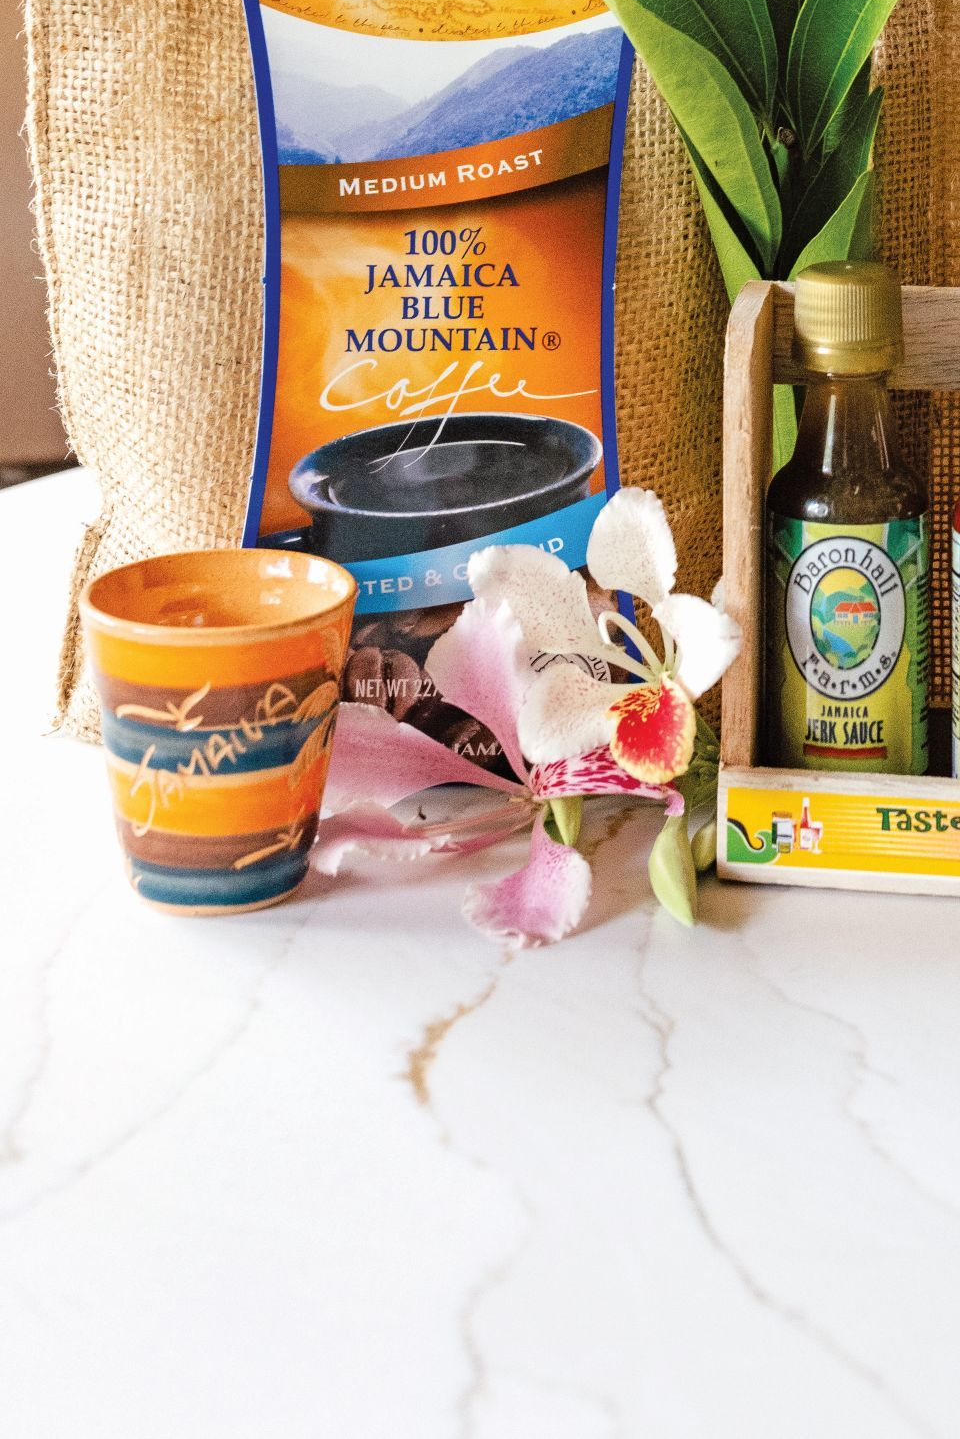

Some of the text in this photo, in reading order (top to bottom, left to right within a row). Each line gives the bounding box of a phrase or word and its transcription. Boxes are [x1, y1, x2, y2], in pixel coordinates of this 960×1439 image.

[338, 149, 544, 197] MEDIUM ROAST
[404, 227, 487, 257] 100%
[365, 263, 520, 294] JAMAICA
[400, 296, 485, 321] BLUE
[320, 359, 599, 473] Coffee
[424, 570, 443, 587] &
[355, 679, 382, 698] NET
[387, 679, 408, 698] WT
[820, 704, 869, 719] JAMAICA
[805, 718, 884, 745] JERK SAUCE
